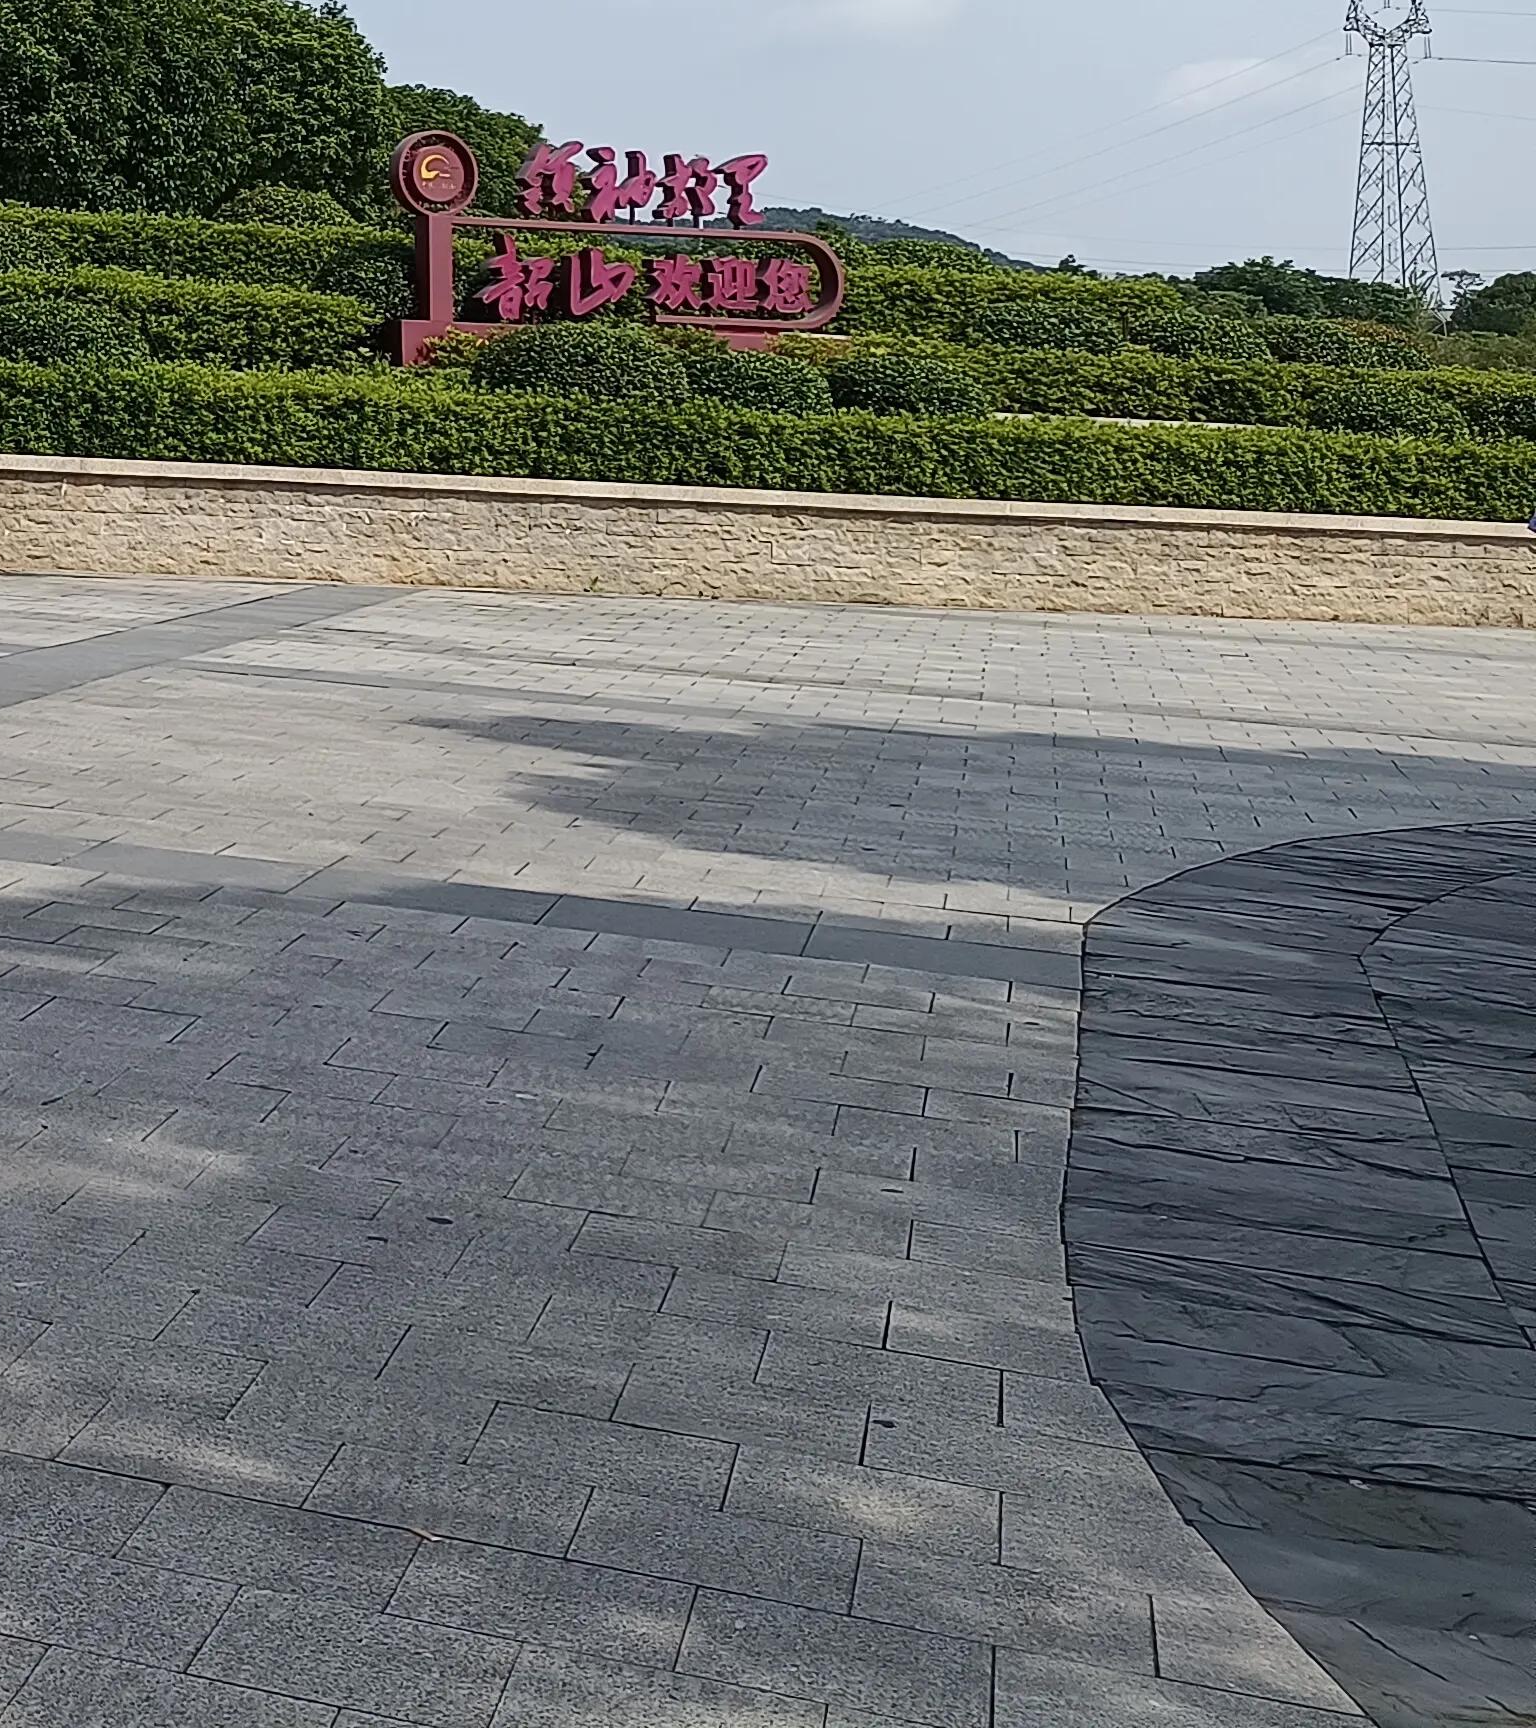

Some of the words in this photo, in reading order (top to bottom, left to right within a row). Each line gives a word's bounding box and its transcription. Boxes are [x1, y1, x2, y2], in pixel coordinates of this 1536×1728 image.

[479, 233, 815, 320] 韶山欢迎您
